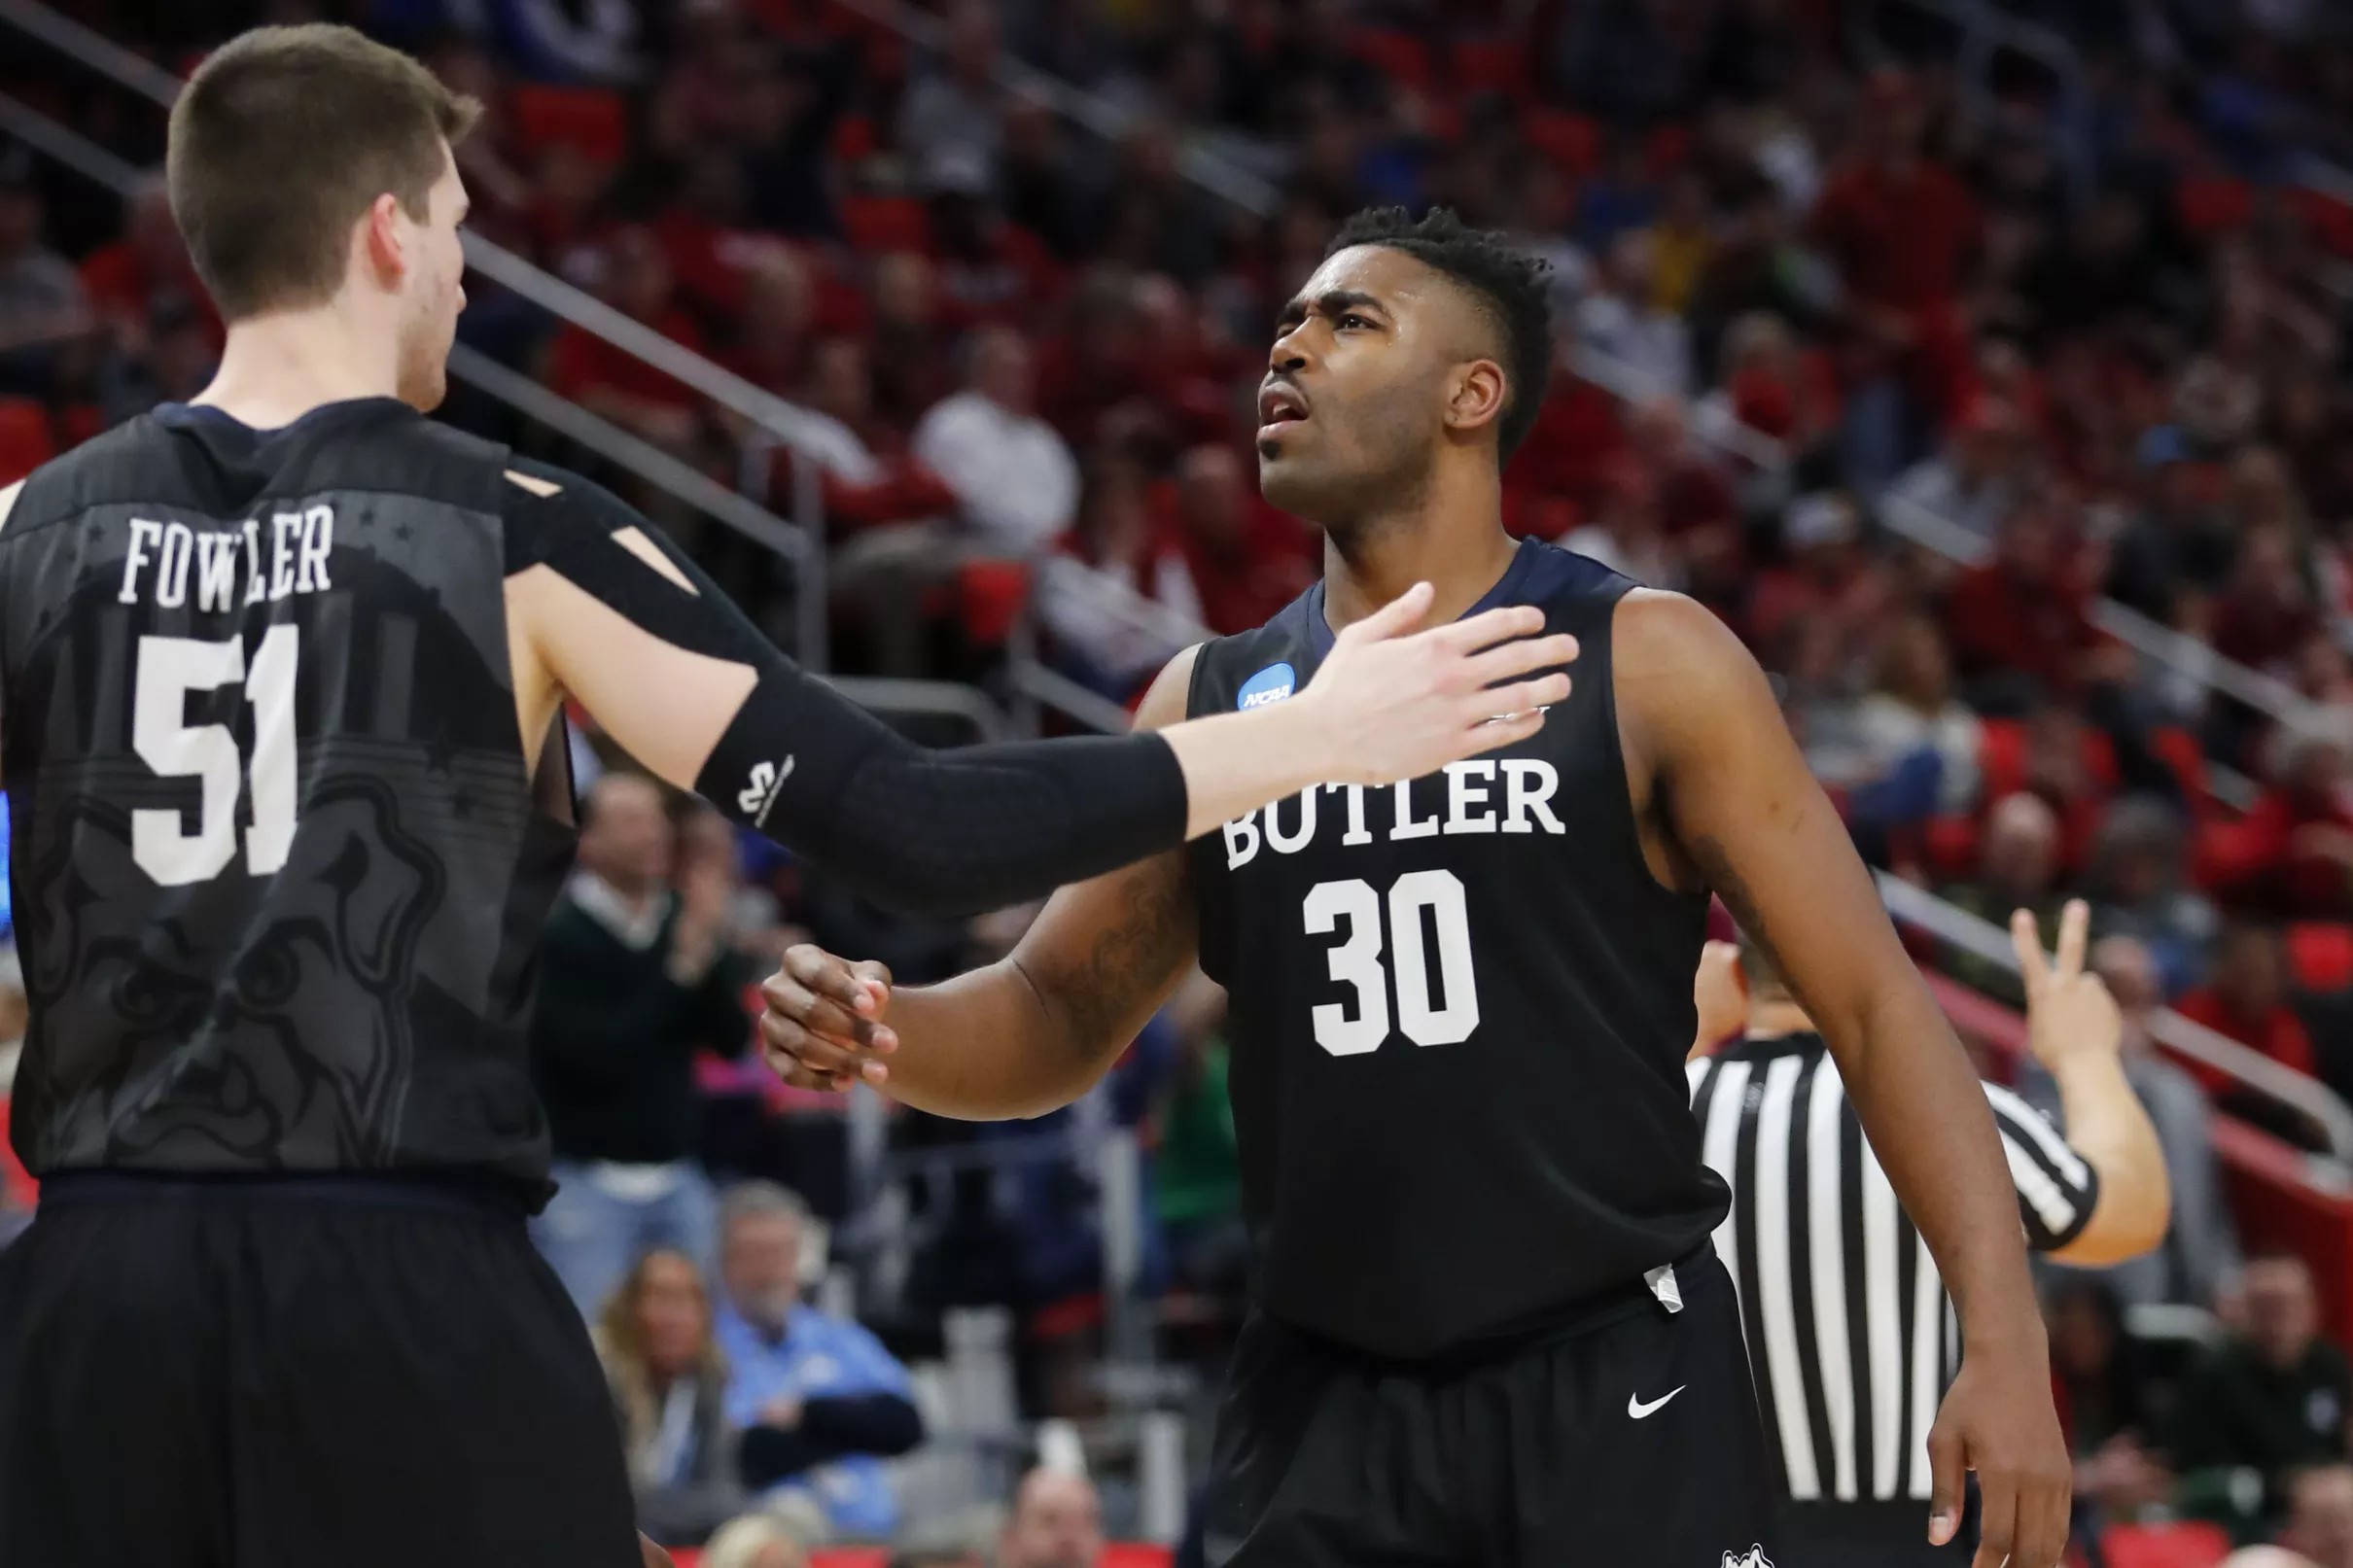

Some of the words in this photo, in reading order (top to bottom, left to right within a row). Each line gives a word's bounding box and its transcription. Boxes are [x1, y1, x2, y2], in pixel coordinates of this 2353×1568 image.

[118, 505, 334, 612] FOWLER
[1244, 684, 1291, 708] NCAA
[131, 623, 299, 887] 51
[1222, 758, 1566, 871] BUTLER
[1303, 868, 1480, 1057] 30
